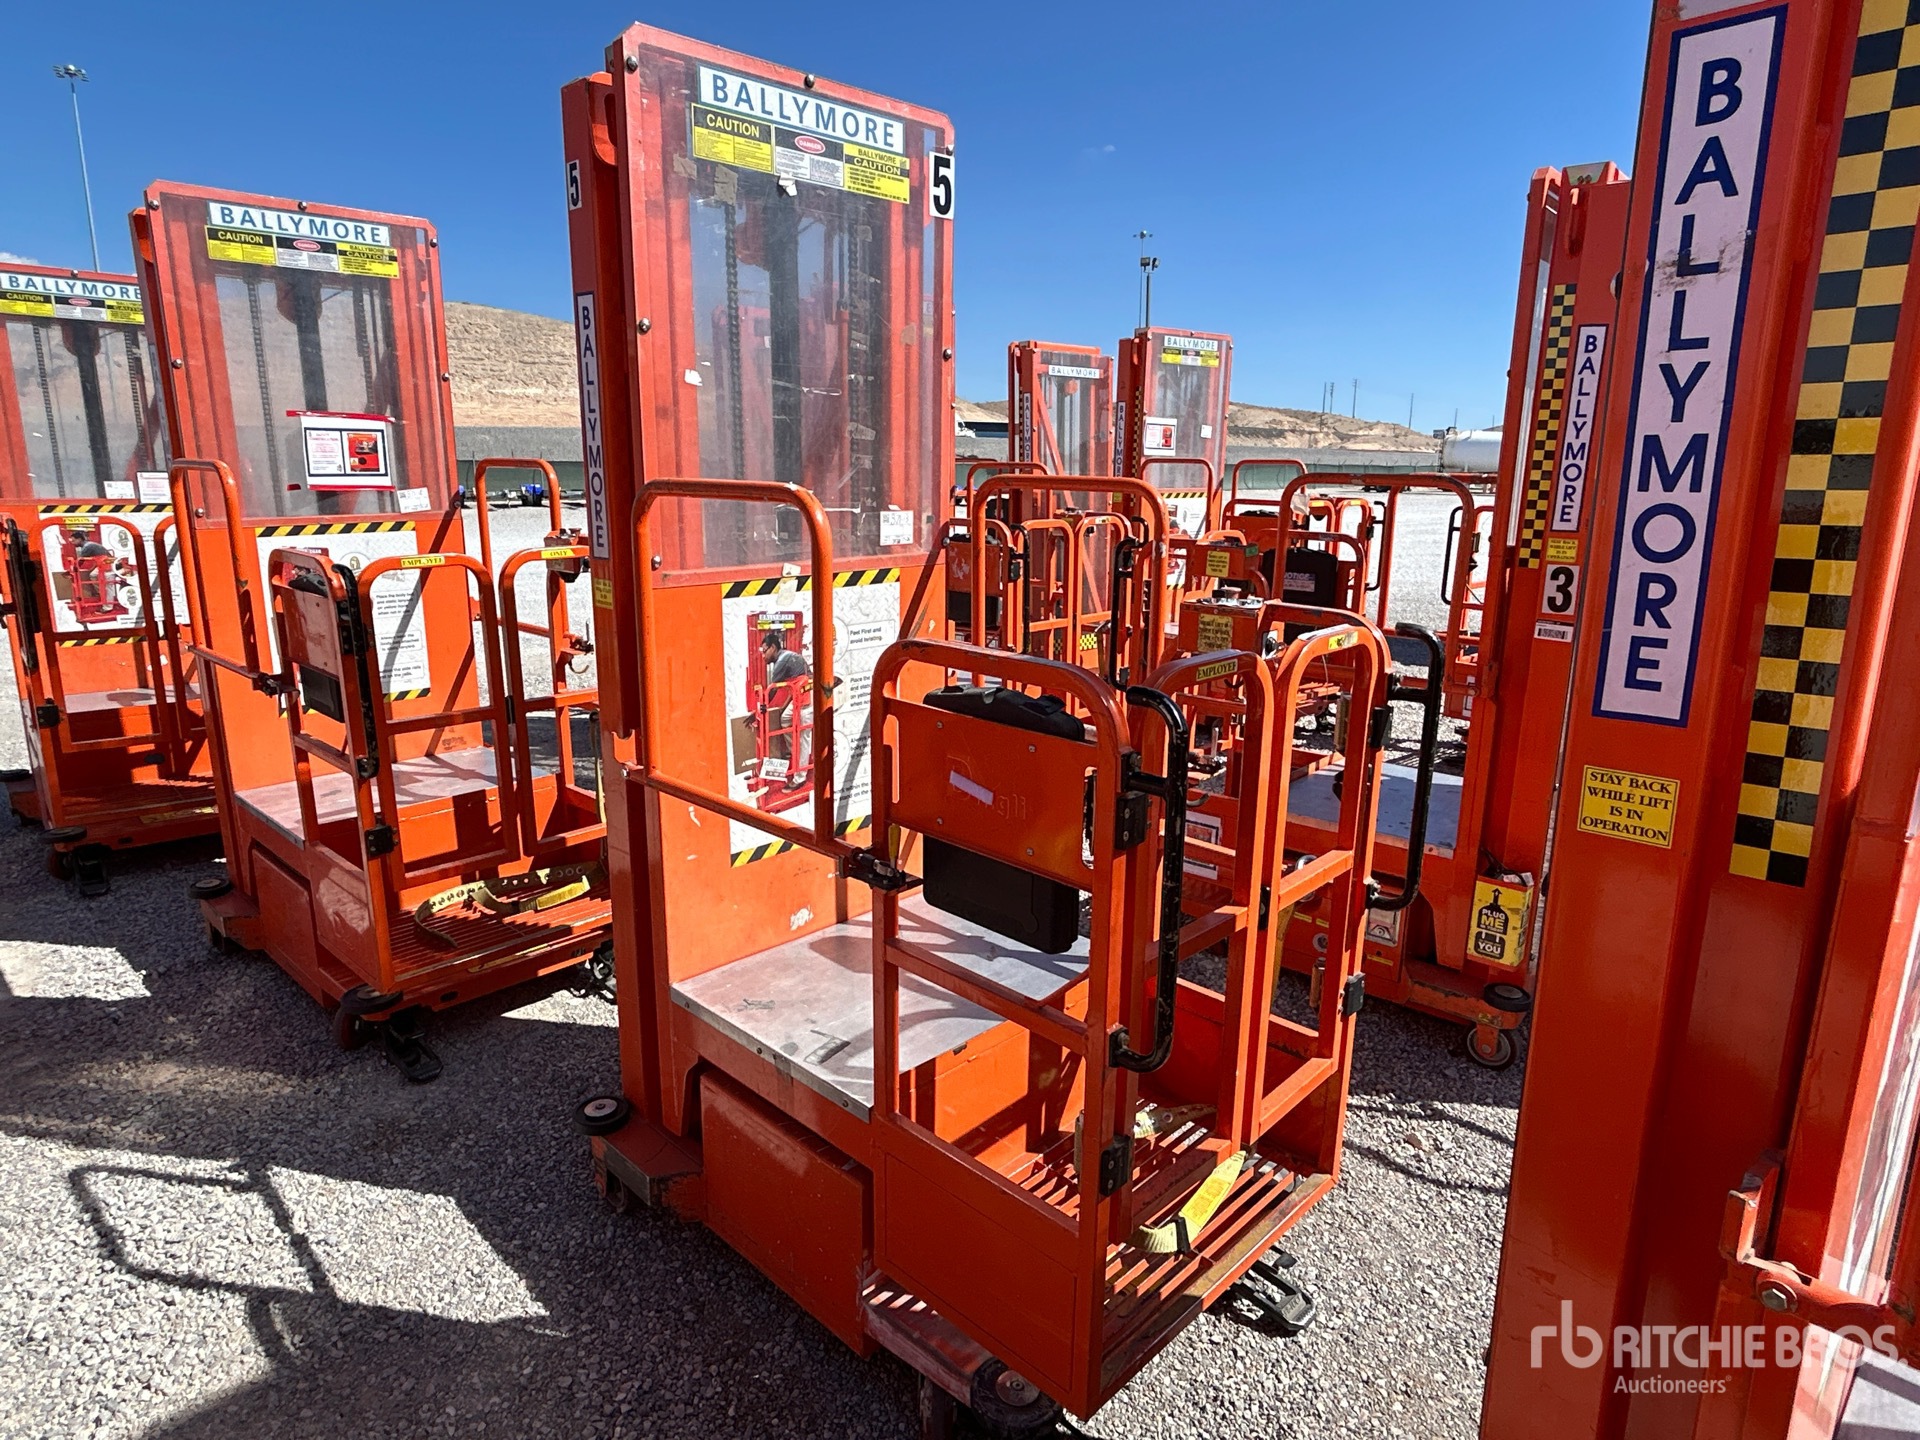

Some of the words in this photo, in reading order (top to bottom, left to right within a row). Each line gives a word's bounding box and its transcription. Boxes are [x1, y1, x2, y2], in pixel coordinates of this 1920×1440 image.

[713, 73, 894, 148] BALLYMORE
[706, 113, 760, 138] CAUTION
[854, 157, 901, 176] CAUTION
[858, 148, 897, 165] BALLYMORE
[568, 162, 580, 207] 5
[933, 155, 952, 216] 5
[220, 206, 382, 243] BALLYMORE
[217, 231, 264, 245] CAUTION
[346, 251, 390, 261] CAUTION
[6, 292, 44, 302] CAUTION
[8, 275, 141, 300] BALLYMORE
[1167, 337, 1215, 350] BALLYMORE
[1051, 366, 1097, 377] BALLYMORE
[1624, 56, 1742, 693] BALLYMORE
[581, 306, 605, 548] BALLYMORE
[1559, 334, 1598, 524] BALLYMORE
[1547, 566, 1574, 613] 3
[1589, 770, 1626, 786] STAY
[1628, 777, 1672, 795] BACK
[1587, 785, 1636, 804] WHILE
[1639, 795, 1673, 810] LIFT
[1609, 805, 1623, 817] IS
[1626, 808, 1644, 821] IN
[1582, 815, 1669, 842] OPERATION
[1481, 914, 1505, 930] ME
[1482, 908, 1506, 920] PLUG
[1478, 941, 1501, 954] YOU
